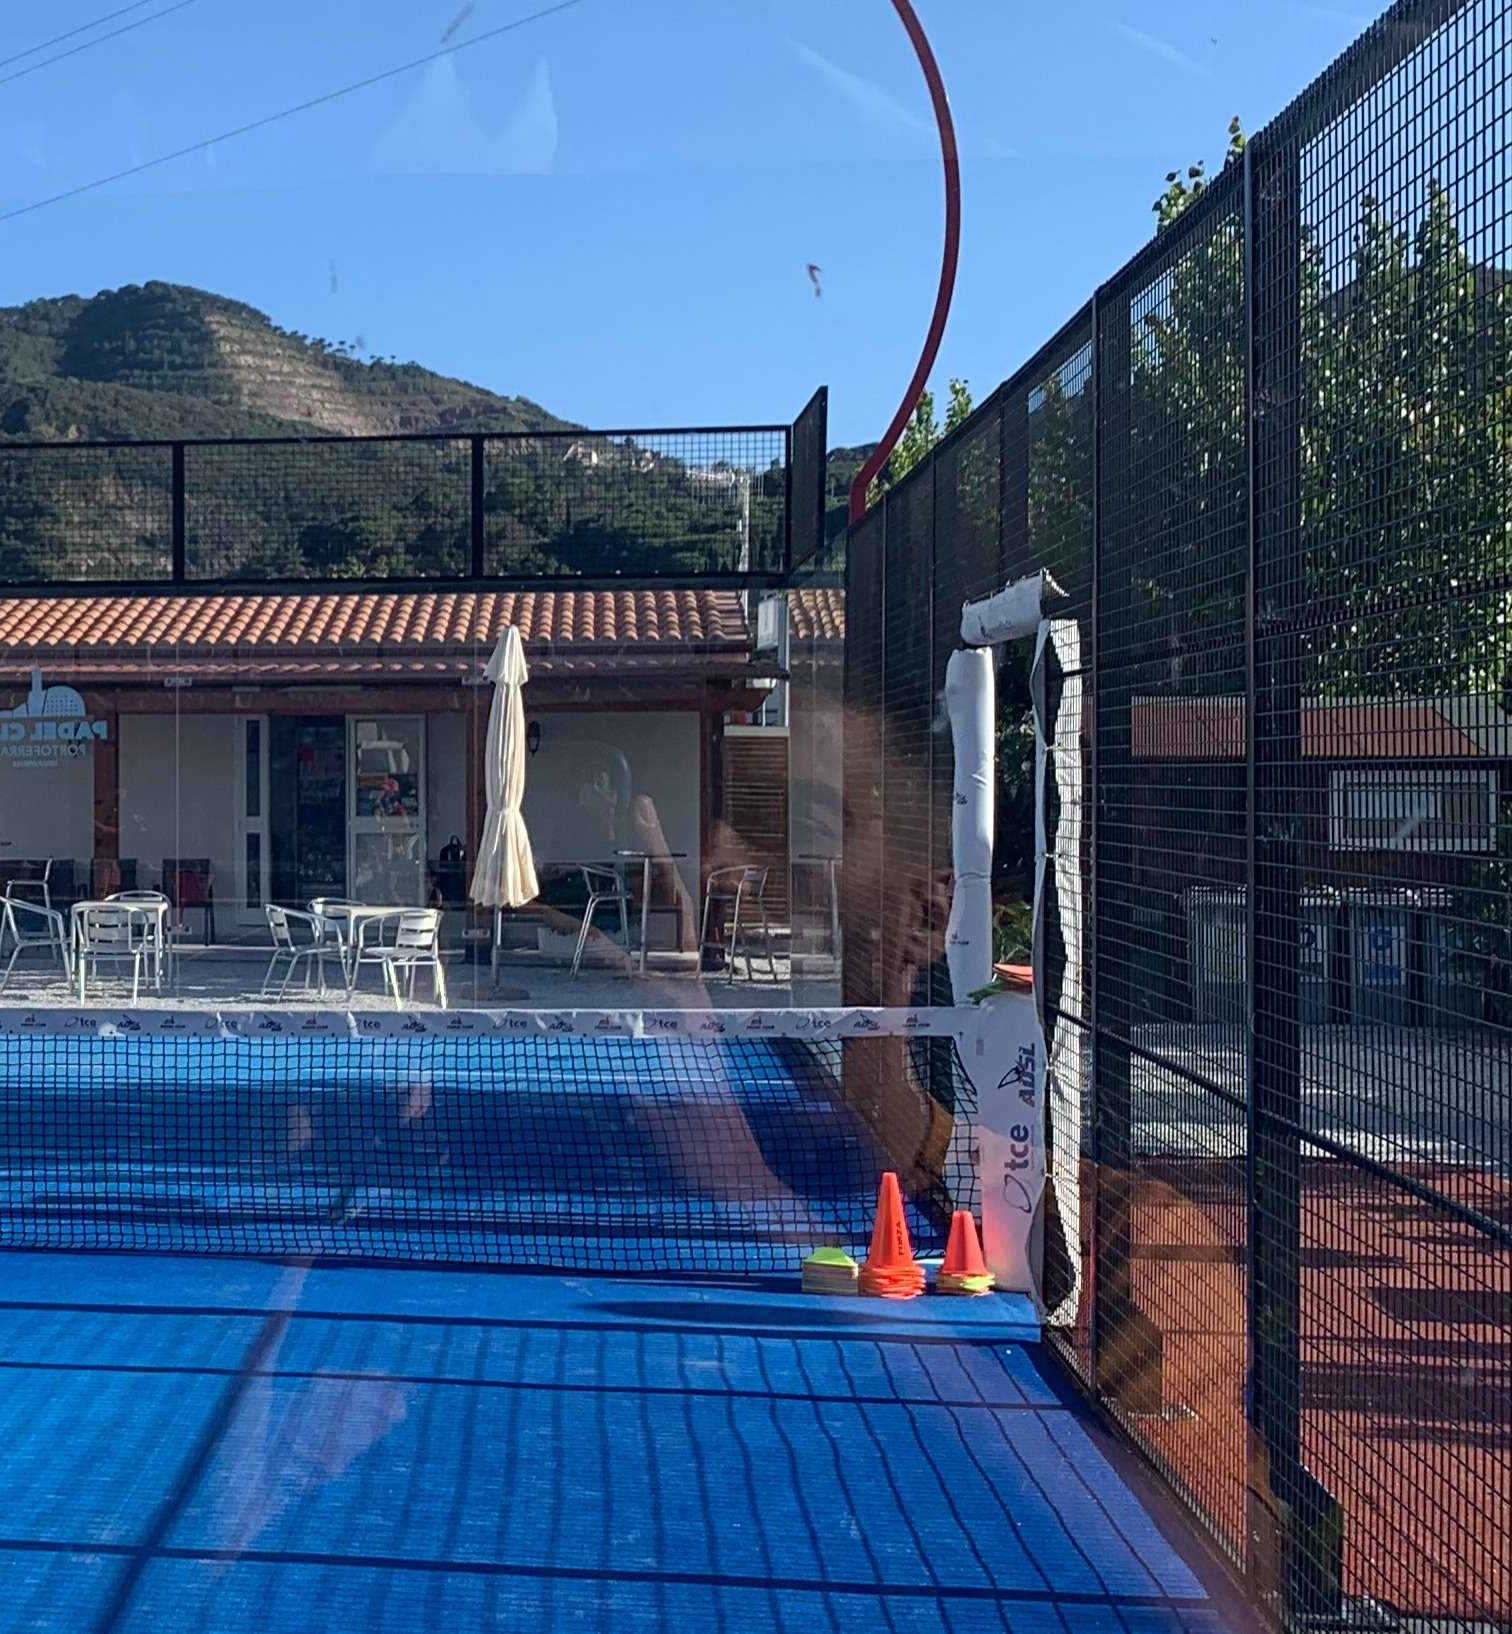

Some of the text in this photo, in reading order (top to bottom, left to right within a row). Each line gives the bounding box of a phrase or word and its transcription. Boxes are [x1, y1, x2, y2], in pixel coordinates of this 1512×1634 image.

[80, 1017, 96, 1027] tce
[362, 1019, 380, 1029] tce
[509, 1019, 527, 1029] tce
[658, 1019, 678, 1029] tce
[812, 1018, 831, 1028] tce
[1017, 1042, 1035, 1107] ADSL
[1004, 1124, 1030, 1171] tce
